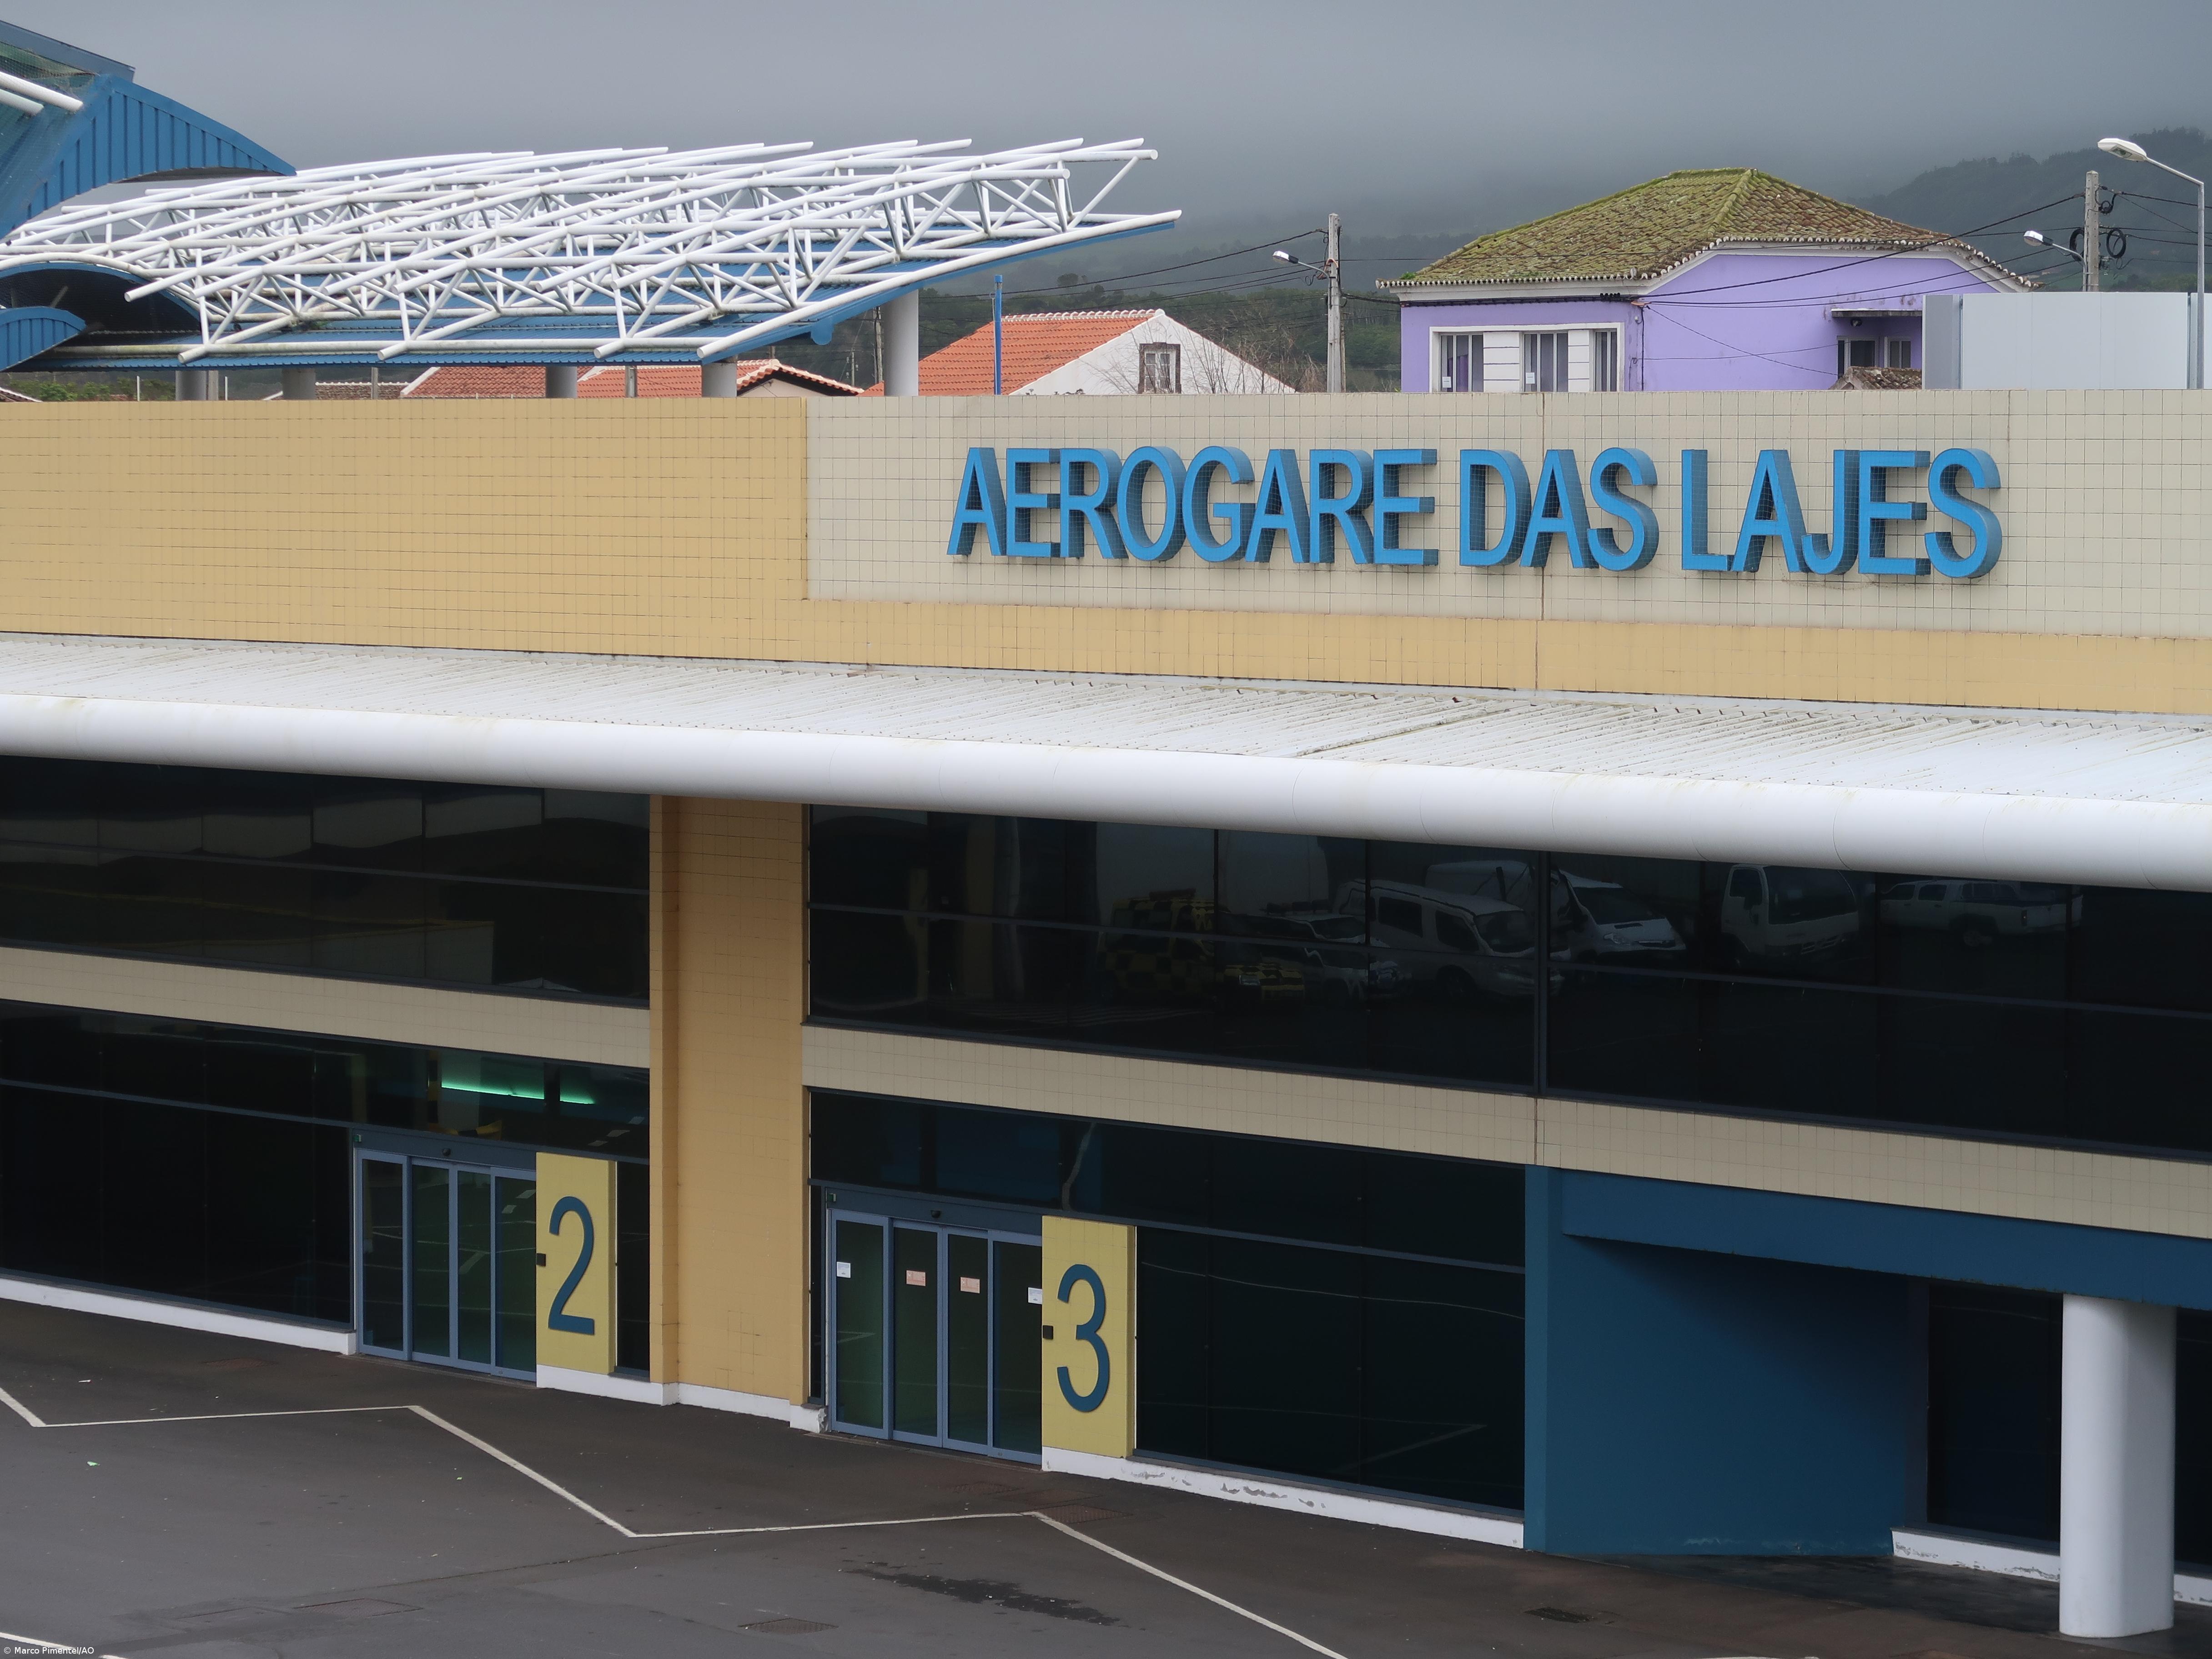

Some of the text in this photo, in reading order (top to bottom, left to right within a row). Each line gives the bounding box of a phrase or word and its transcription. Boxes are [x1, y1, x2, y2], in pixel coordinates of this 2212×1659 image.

[947, 446, 2002, 578] AEROGARE DAS LAJES
[548, 1196, 595, 1335] 2
[1057, 1264, 1110, 1413] 3
